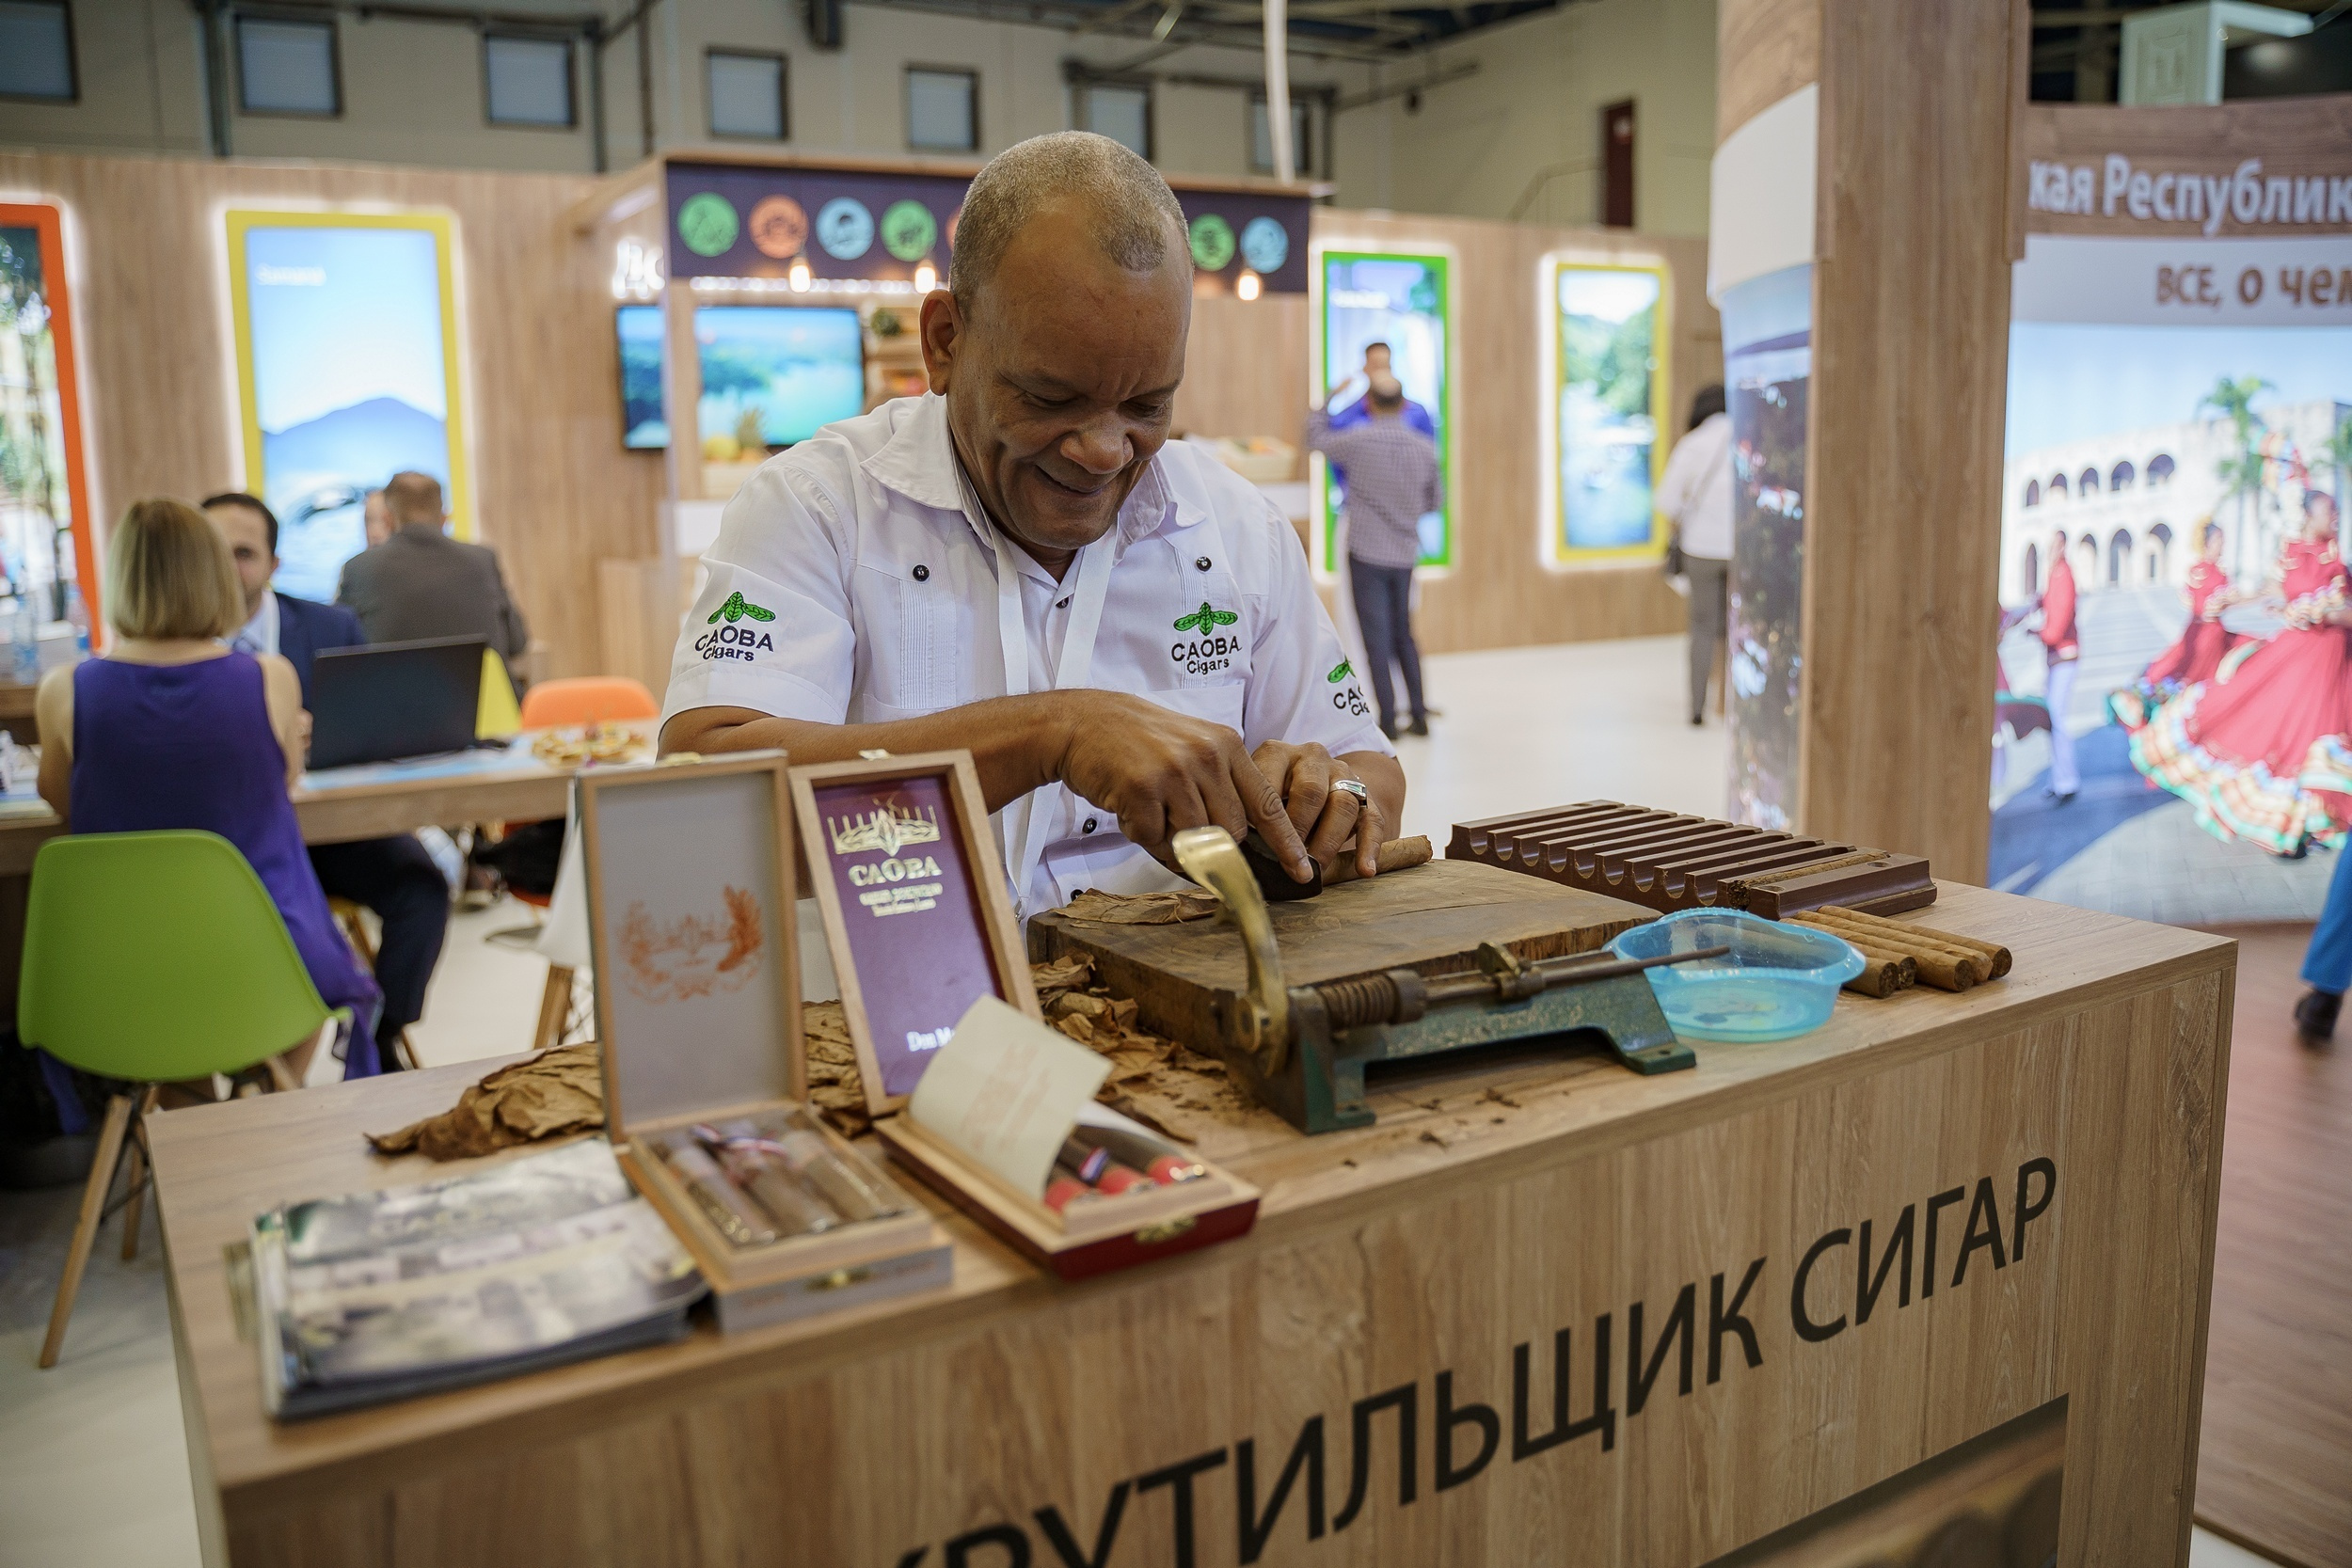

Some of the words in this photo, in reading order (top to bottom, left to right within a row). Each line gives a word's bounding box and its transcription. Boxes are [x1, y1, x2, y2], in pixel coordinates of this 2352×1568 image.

[2028, 160, 2094, 215] кая
[2102, 153, 2352, 239] Республик
[2155, 264, 2222, 309] ВСЕ,
[2237, 267, 2264, 307] о
[694, 625, 774, 653] CAOBA
[702, 645, 755, 661] Cigars
[1170, 635, 1241, 662] CAOBA
[1186, 657, 1230, 675] Cigars
[848, 856, 943, 887] CAOBA
[896, 1256, 1769, 1568] УТИЛЬЩИК
[1789, 1156, 2058, 1343] СИГАР
